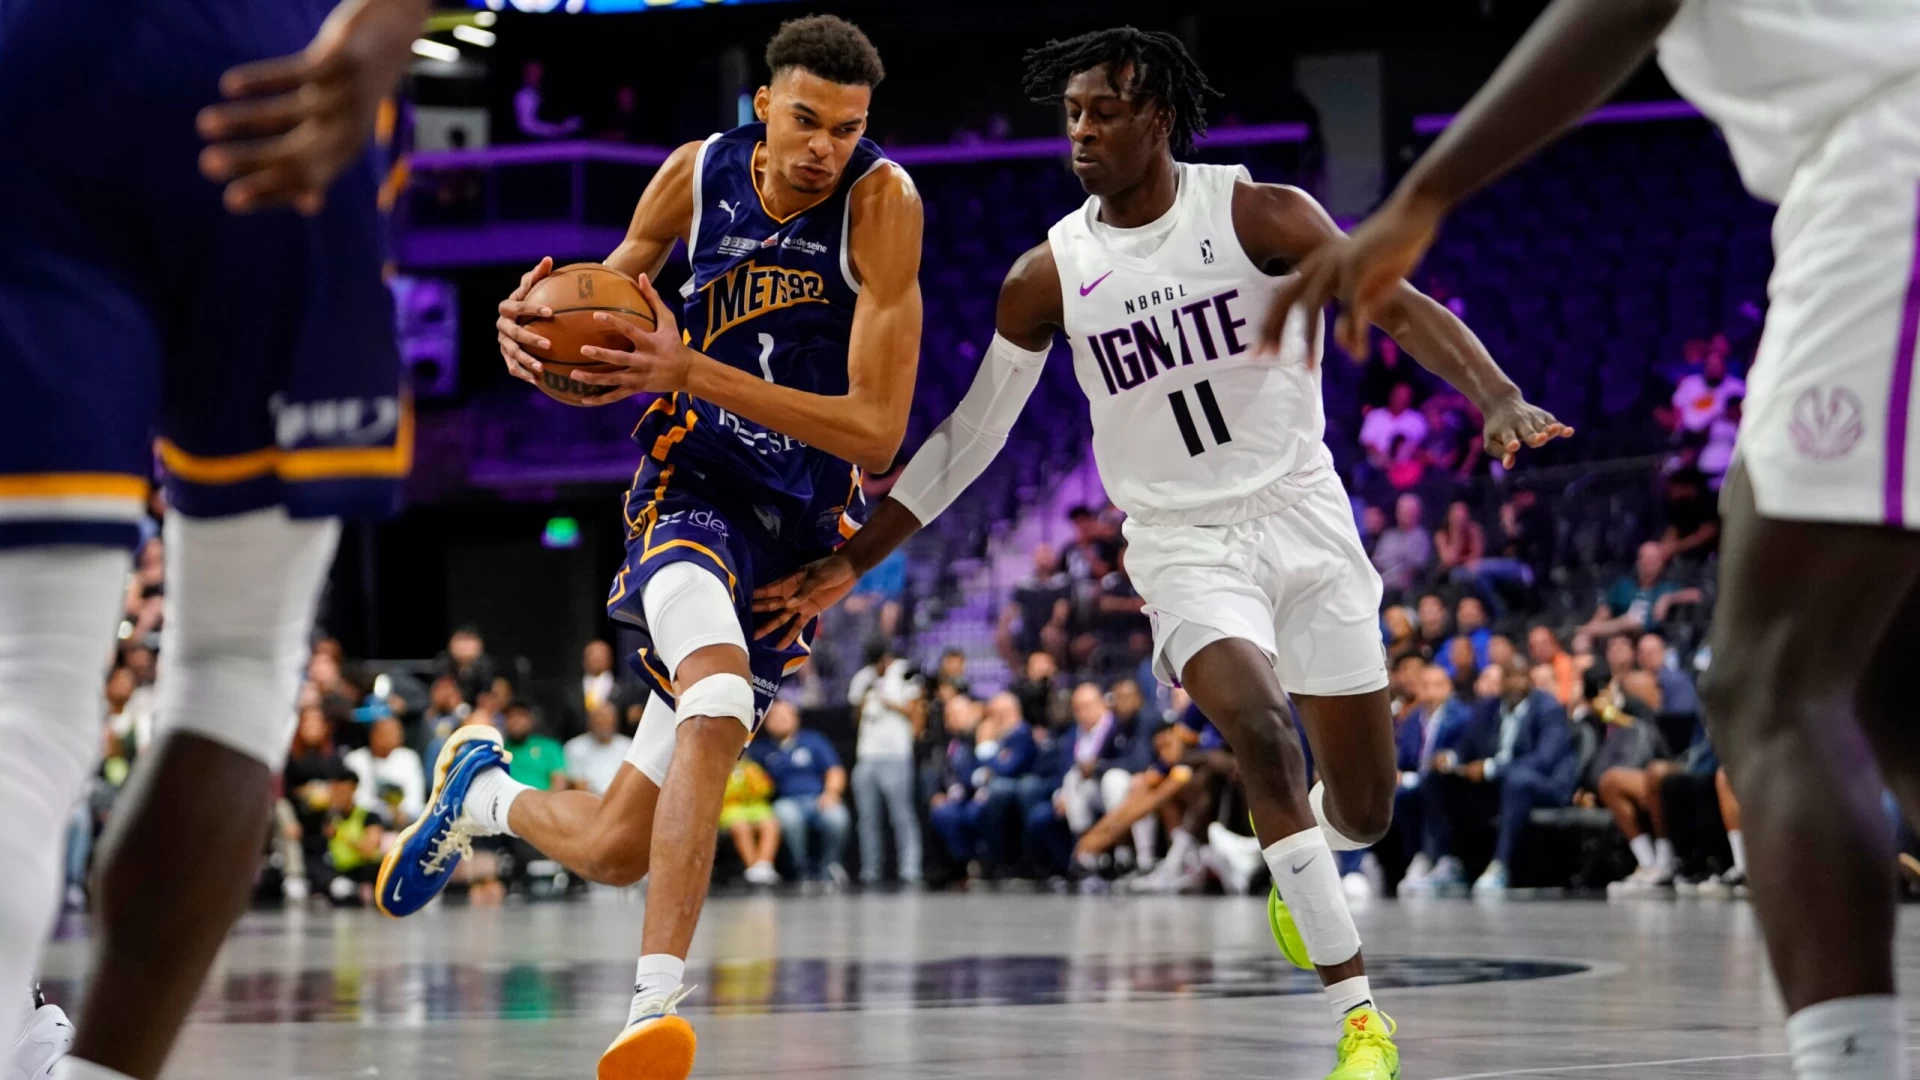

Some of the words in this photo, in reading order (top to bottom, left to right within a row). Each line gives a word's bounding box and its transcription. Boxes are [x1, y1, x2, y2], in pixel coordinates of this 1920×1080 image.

[1124, 284, 1188, 315] NBAGL
[757, 332, 775, 383] 1
[1087, 289, 1248, 396] IGNITE
[1167, 379, 1233, 458] 11
